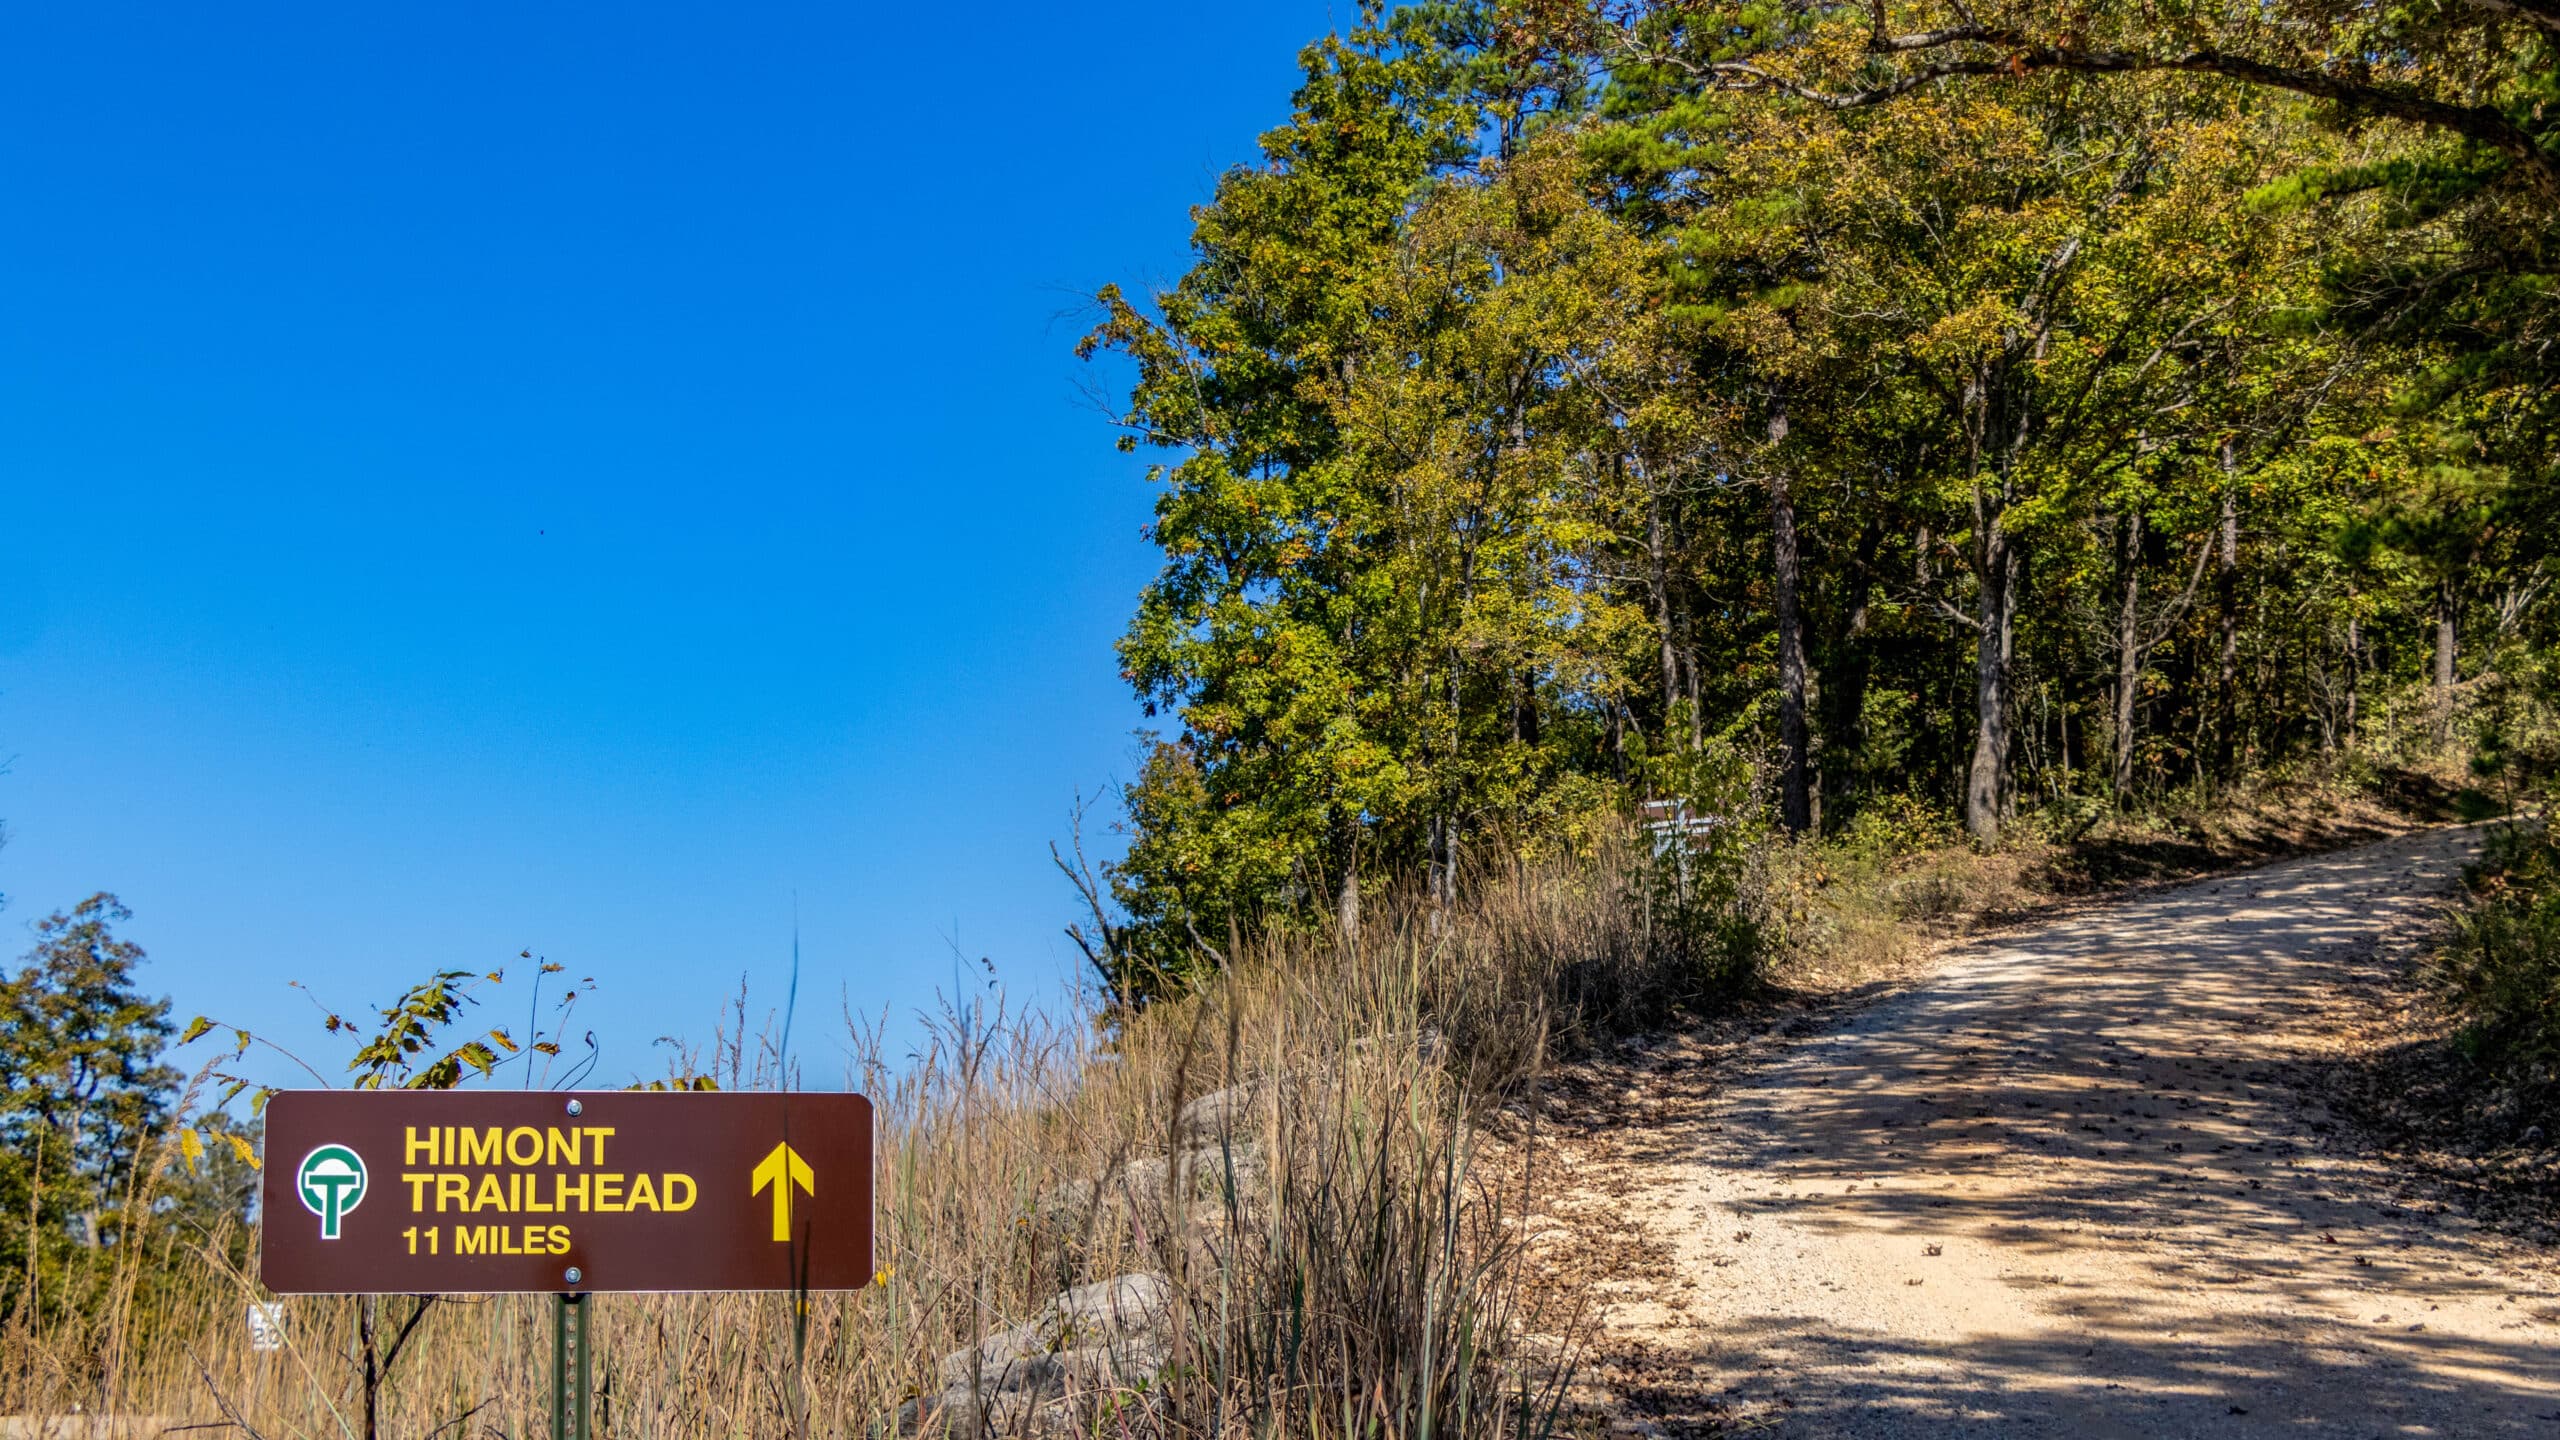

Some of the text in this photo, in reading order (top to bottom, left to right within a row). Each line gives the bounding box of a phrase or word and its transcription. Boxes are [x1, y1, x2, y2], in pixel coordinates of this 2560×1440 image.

[404, 1126, 616, 1167] HIMONT
[402, 1173, 698, 1213] TRAILHEAD
[402, 1225, 572, 1255] 11 MILES
